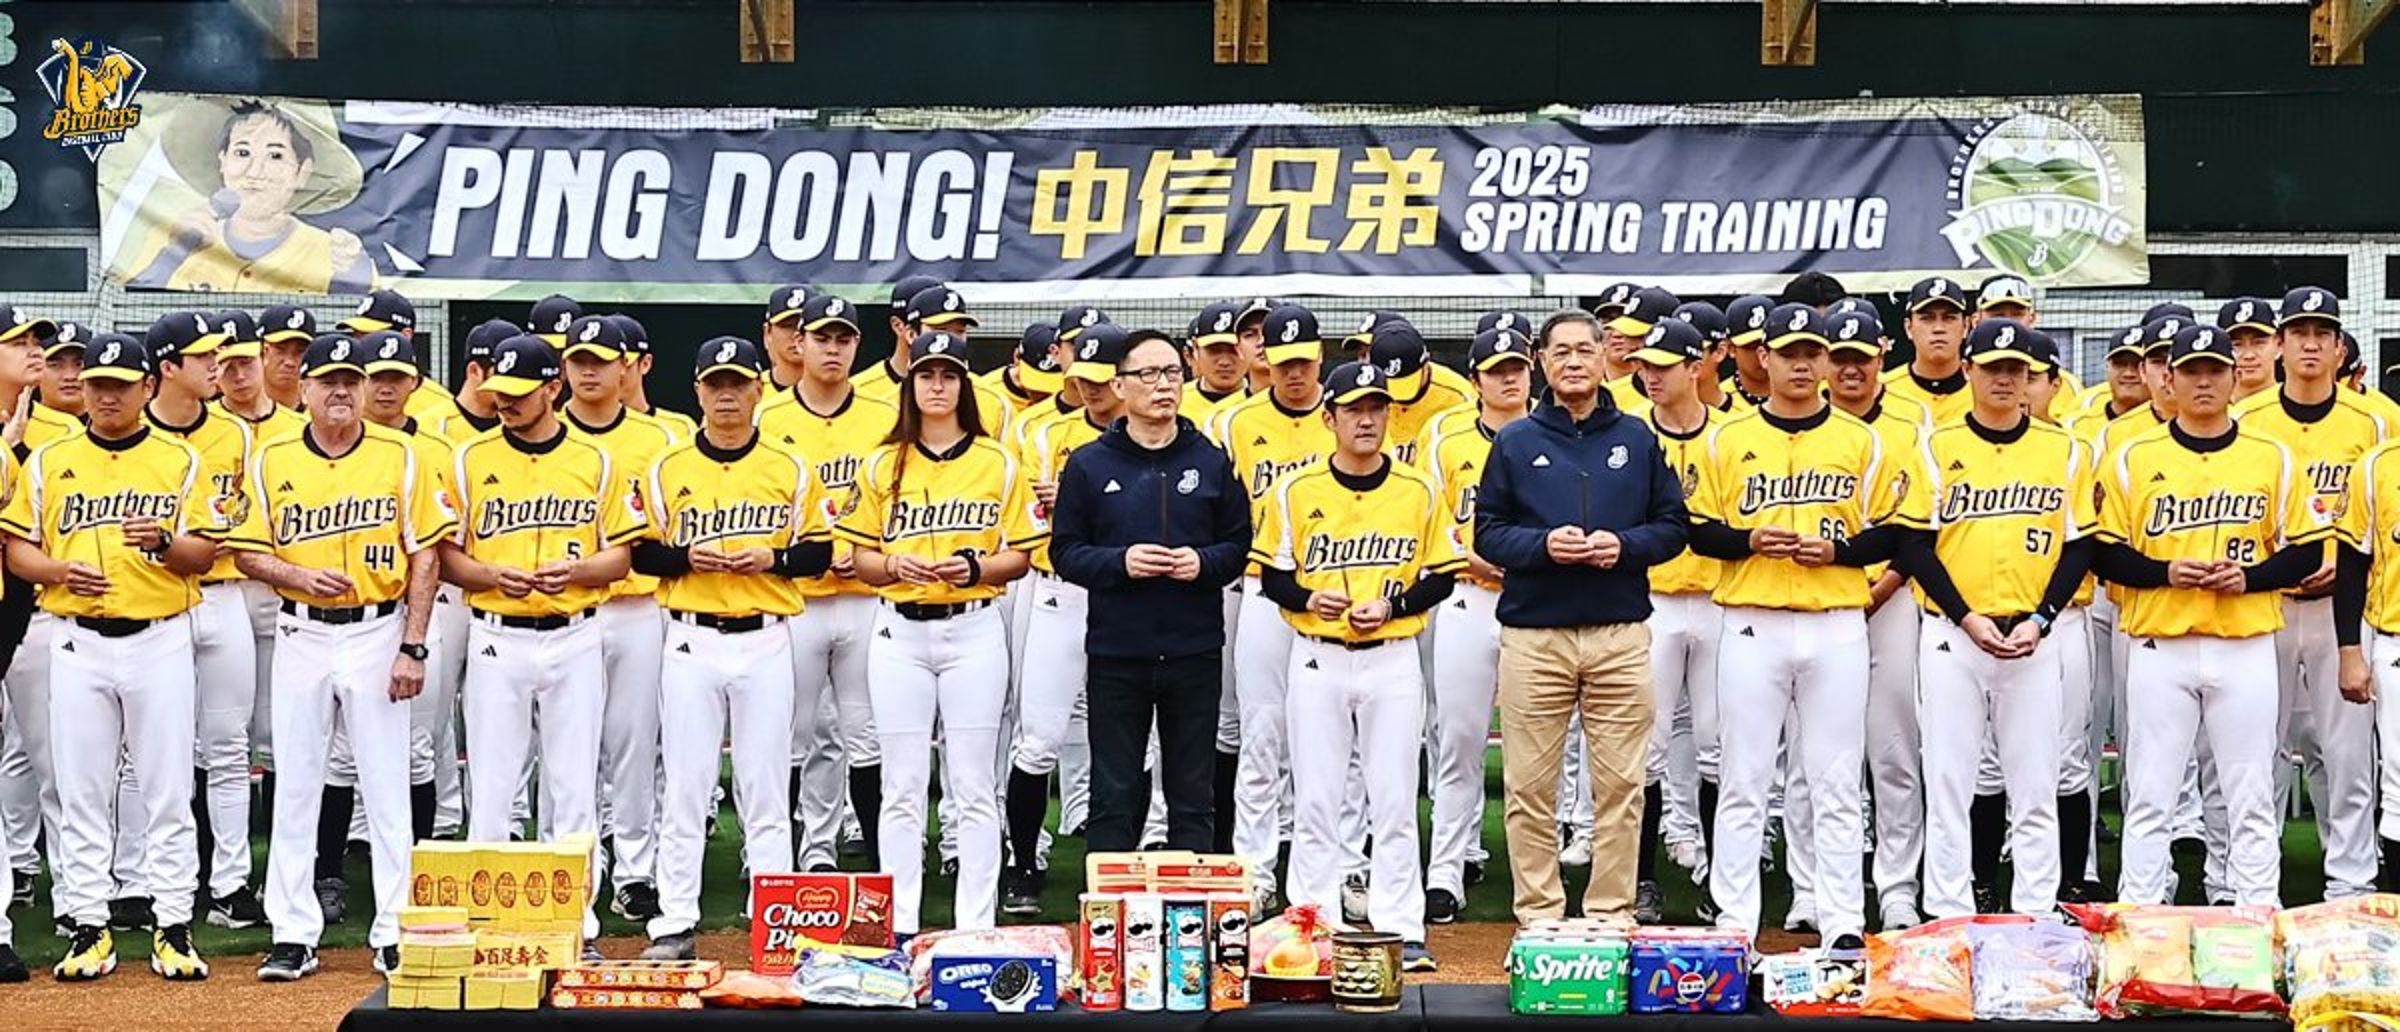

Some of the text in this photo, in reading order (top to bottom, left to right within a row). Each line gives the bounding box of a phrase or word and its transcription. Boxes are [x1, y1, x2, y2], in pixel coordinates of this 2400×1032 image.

[1467, 145, 1592, 197] 2025
[427, 146, 1015, 263] PING DONG!
[1029, 146, 1445, 260] 中信兄弟
[1460, 198, 1888, 255] SPRING TRAINING
[58, 486, 179, 535] Brothers
[475, 490, 598, 540] Brothers
[1739, 469, 1857, 516] Brothers
[1940, 480, 2065, 524] Brothers
[2145, 488, 2268, 537] Brothers
[277, 489, 398, 546] Brothers
[675, 496, 792, 548] Brothers
[882, 497, 1001, 543] Brothers
[1819, 516, 1846, 541] 66
[364, 545, 395, 571] 44
[566, 541, 581, 561] 5
[1305, 531, 1418, 574] Brothers
[2026, 528, 2053, 556] 57
[2226, 537, 2257, 563] 82
[763, 903, 840, 928] Choco
[763, 928, 796, 951] Pi
[939, 963, 993, 985] OREO
[1528, 953, 1613, 987] Sprite
